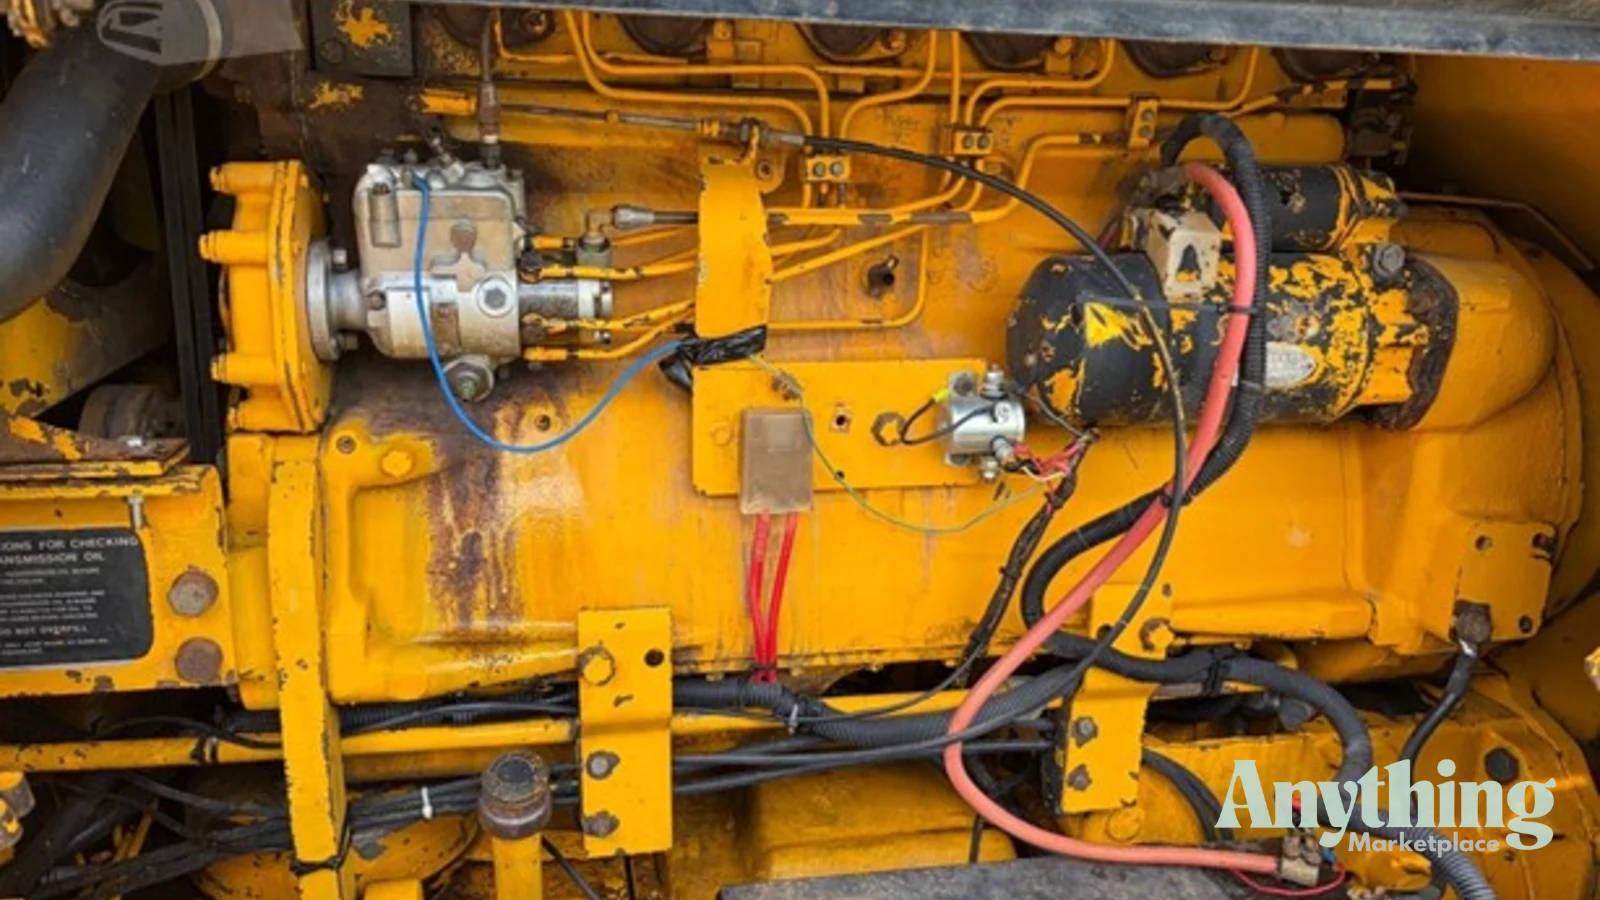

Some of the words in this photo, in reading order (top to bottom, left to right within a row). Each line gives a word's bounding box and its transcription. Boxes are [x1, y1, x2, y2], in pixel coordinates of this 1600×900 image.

[39, 538, 65, 550] FOR
[70, 536, 138, 549] CHECKING
[83, 551, 104, 562] OIL
